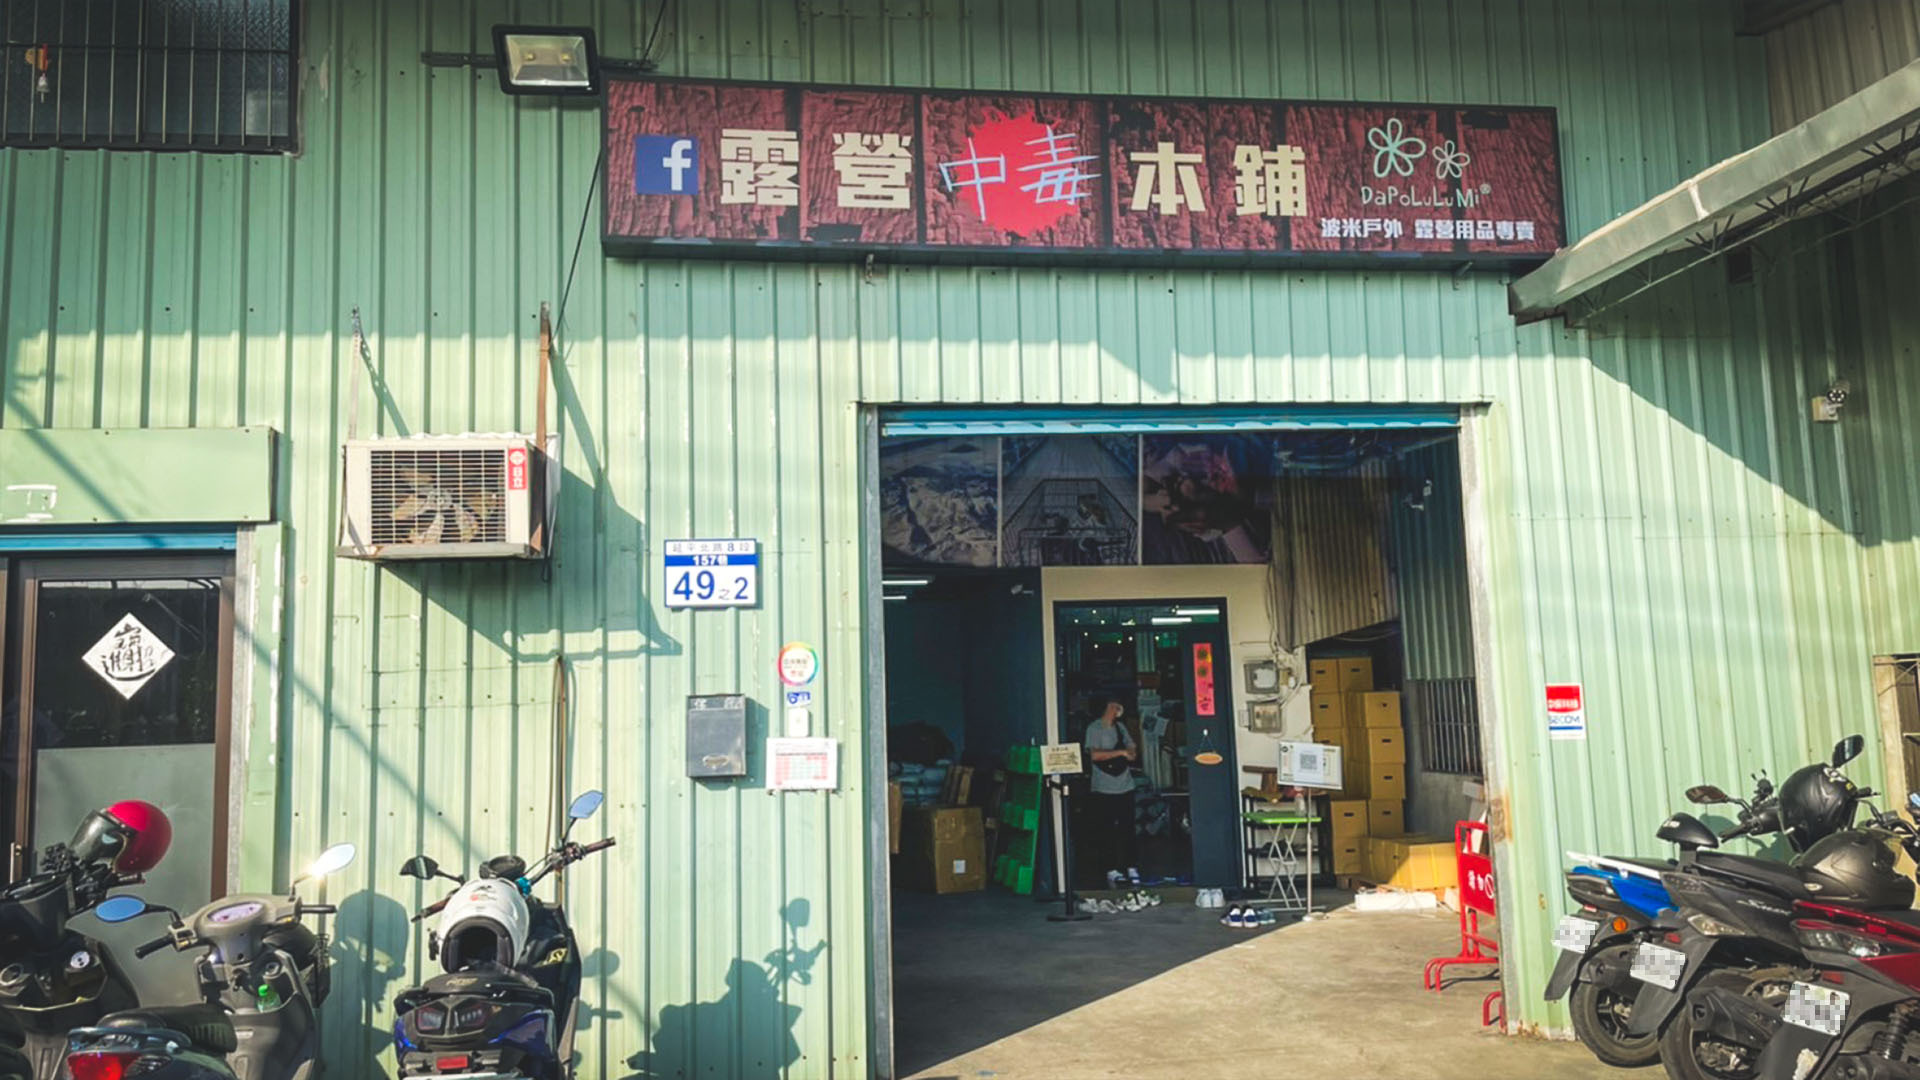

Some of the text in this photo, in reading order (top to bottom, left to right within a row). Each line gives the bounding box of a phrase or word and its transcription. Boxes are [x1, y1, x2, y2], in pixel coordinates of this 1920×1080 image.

[1321, 218, 1535, 240] 波米戶外 露營用品專賣
[673, 570, 748, 601] 49之2
